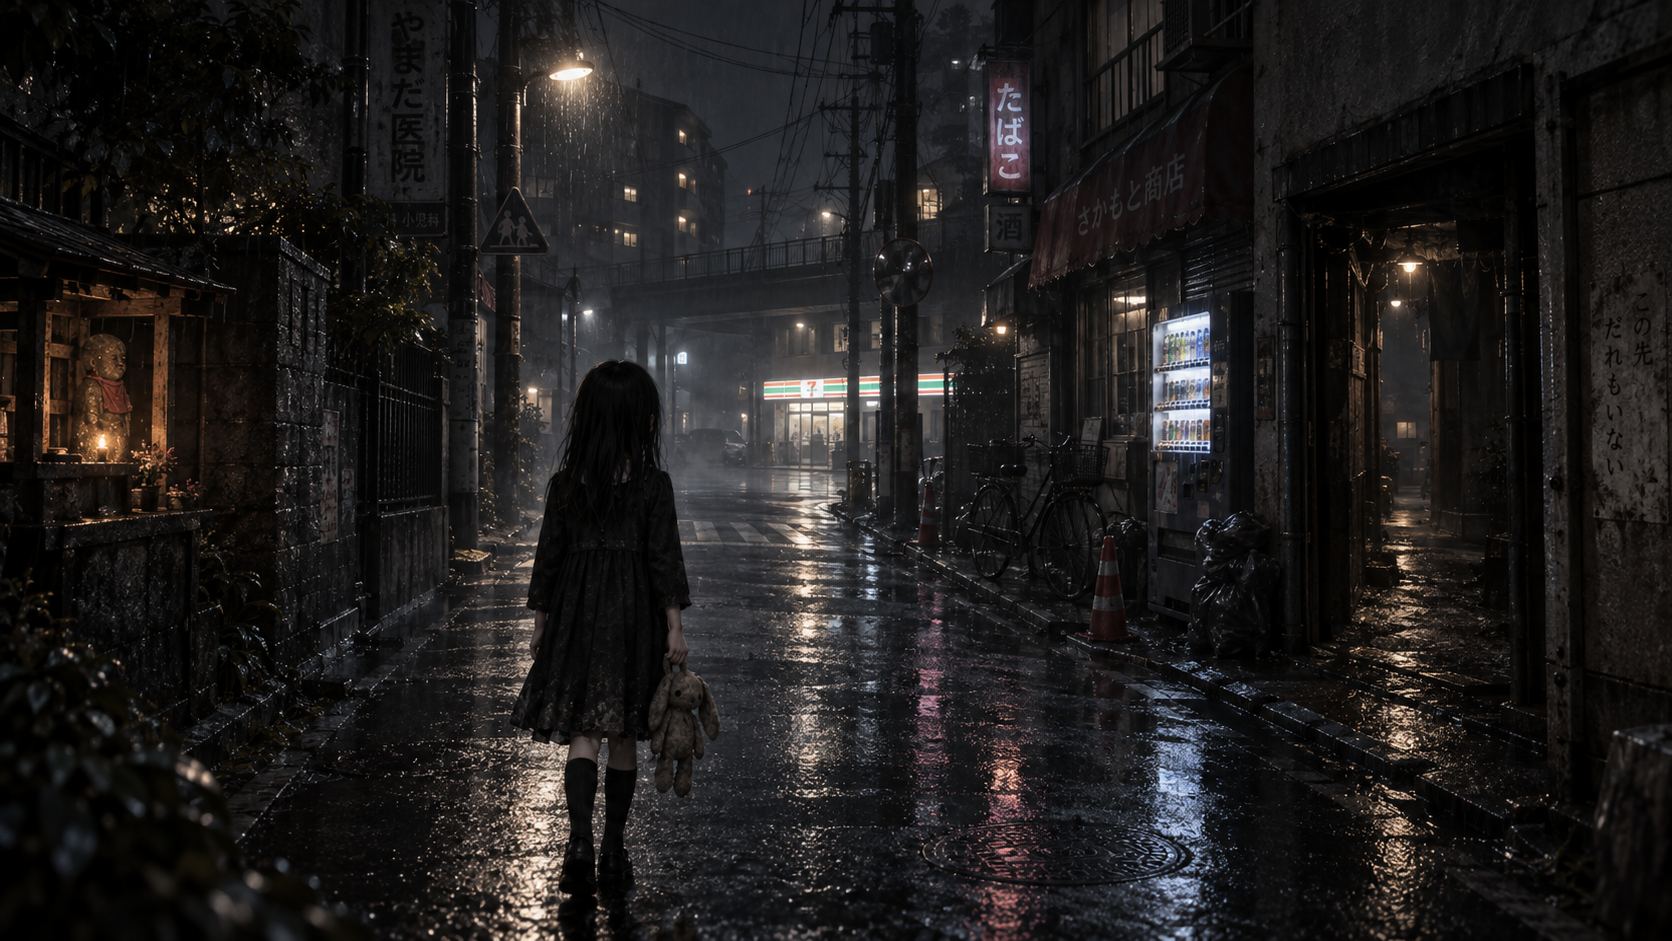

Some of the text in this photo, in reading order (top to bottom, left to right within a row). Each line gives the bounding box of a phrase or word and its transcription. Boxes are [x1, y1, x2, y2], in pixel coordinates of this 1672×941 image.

[391, 11, 425, 183] やまだ医院
[997, 82, 1024, 180] たばこ
[402, 212, 439, 228] 小児科
[996, 212, 1023, 241] 酒
[1078, 153, 1186, 236] さかもと商店
[1633, 293, 1653, 367] この先
[1605, 316, 1624, 475] だれもいない
